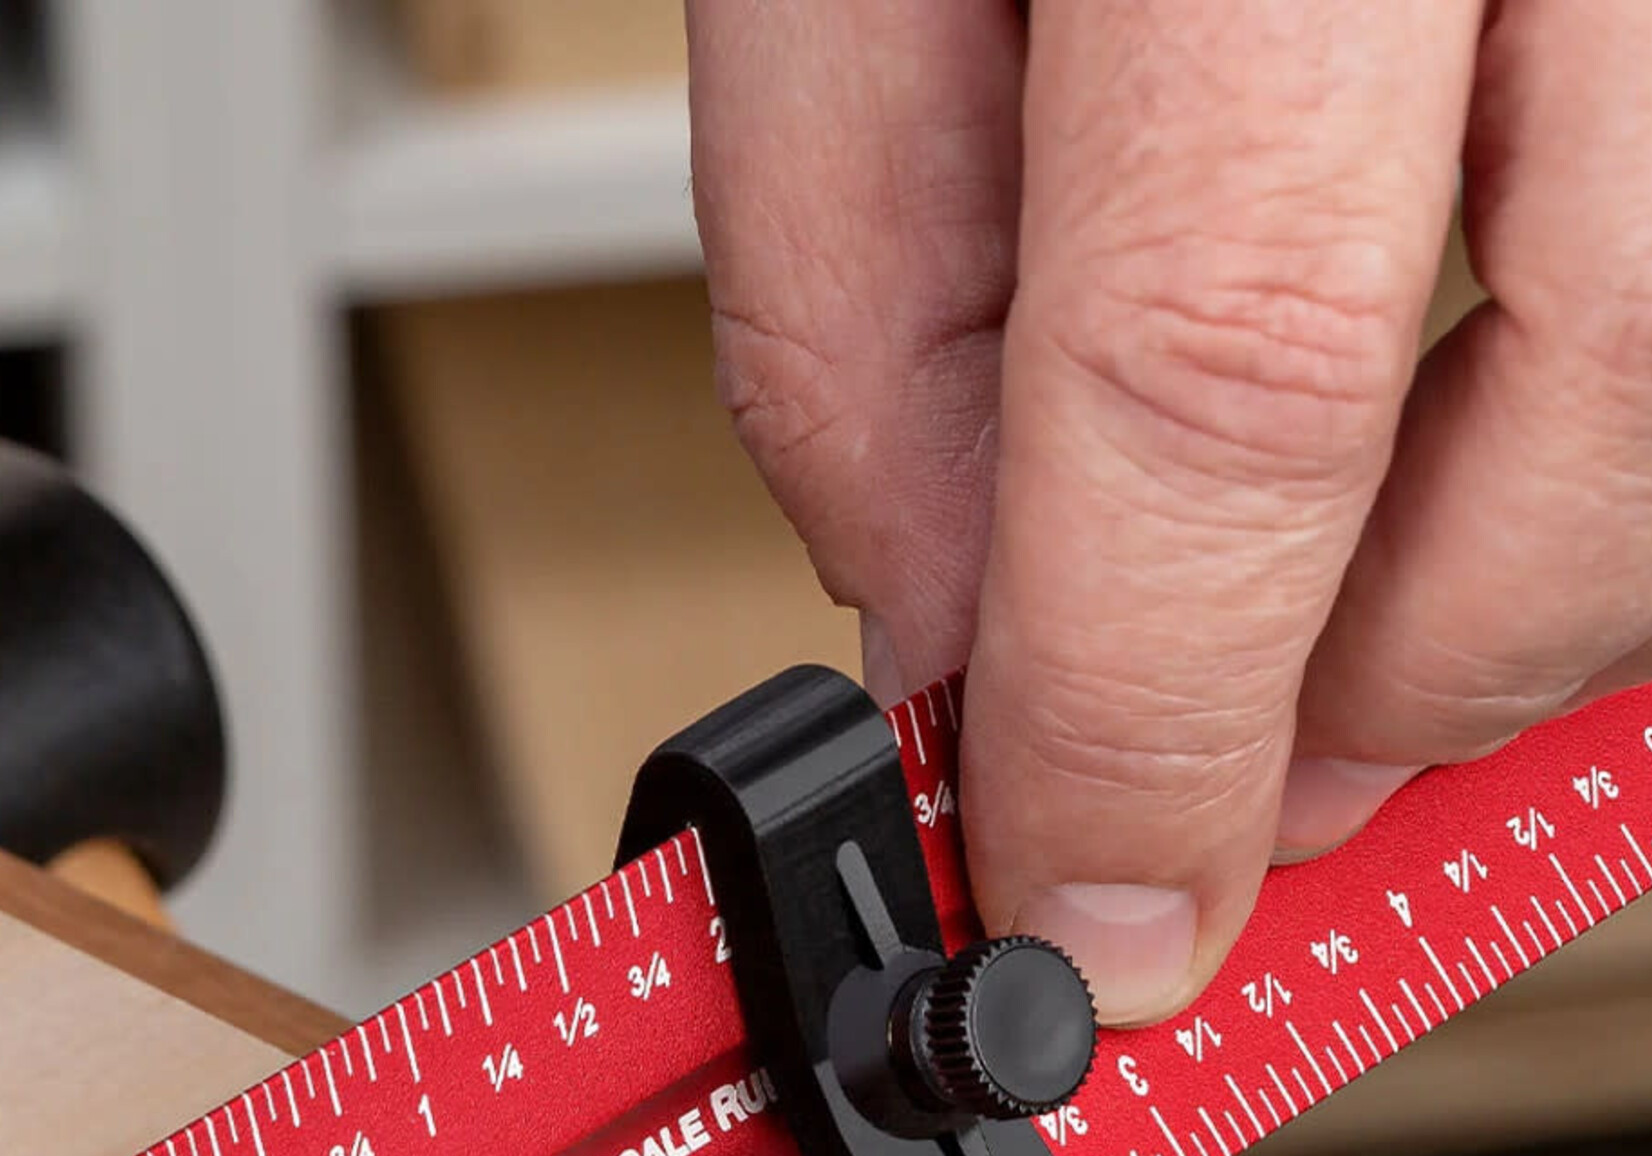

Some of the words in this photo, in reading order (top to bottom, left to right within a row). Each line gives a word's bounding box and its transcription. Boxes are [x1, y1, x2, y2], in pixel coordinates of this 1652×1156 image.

[1573, 766, 1619, 809] 3/4
[1506, 808, 1555, 850] 1/2
[1443, 849, 1488, 893] 1/4
[1386, 890, 1412, 927] 4
[418, 1094, 436, 1137] 1
[482, 1043, 523, 1092] 1/4
[553, 997, 599, 1046] 1/2
[628, 952, 671, 1000] 3/4
[710, 916, 731, 963] 2
[914, 780, 956, 828] 3/4
[1310, 929, 1358, 974] 3/4
[1241, 973, 1292, 1018] 1/2
[1175, 1016, 1222, 1062] 1/4
[1118, 1055, 1149, 1096] 3
[1039, 1105, 1088, 1146] 3/4
